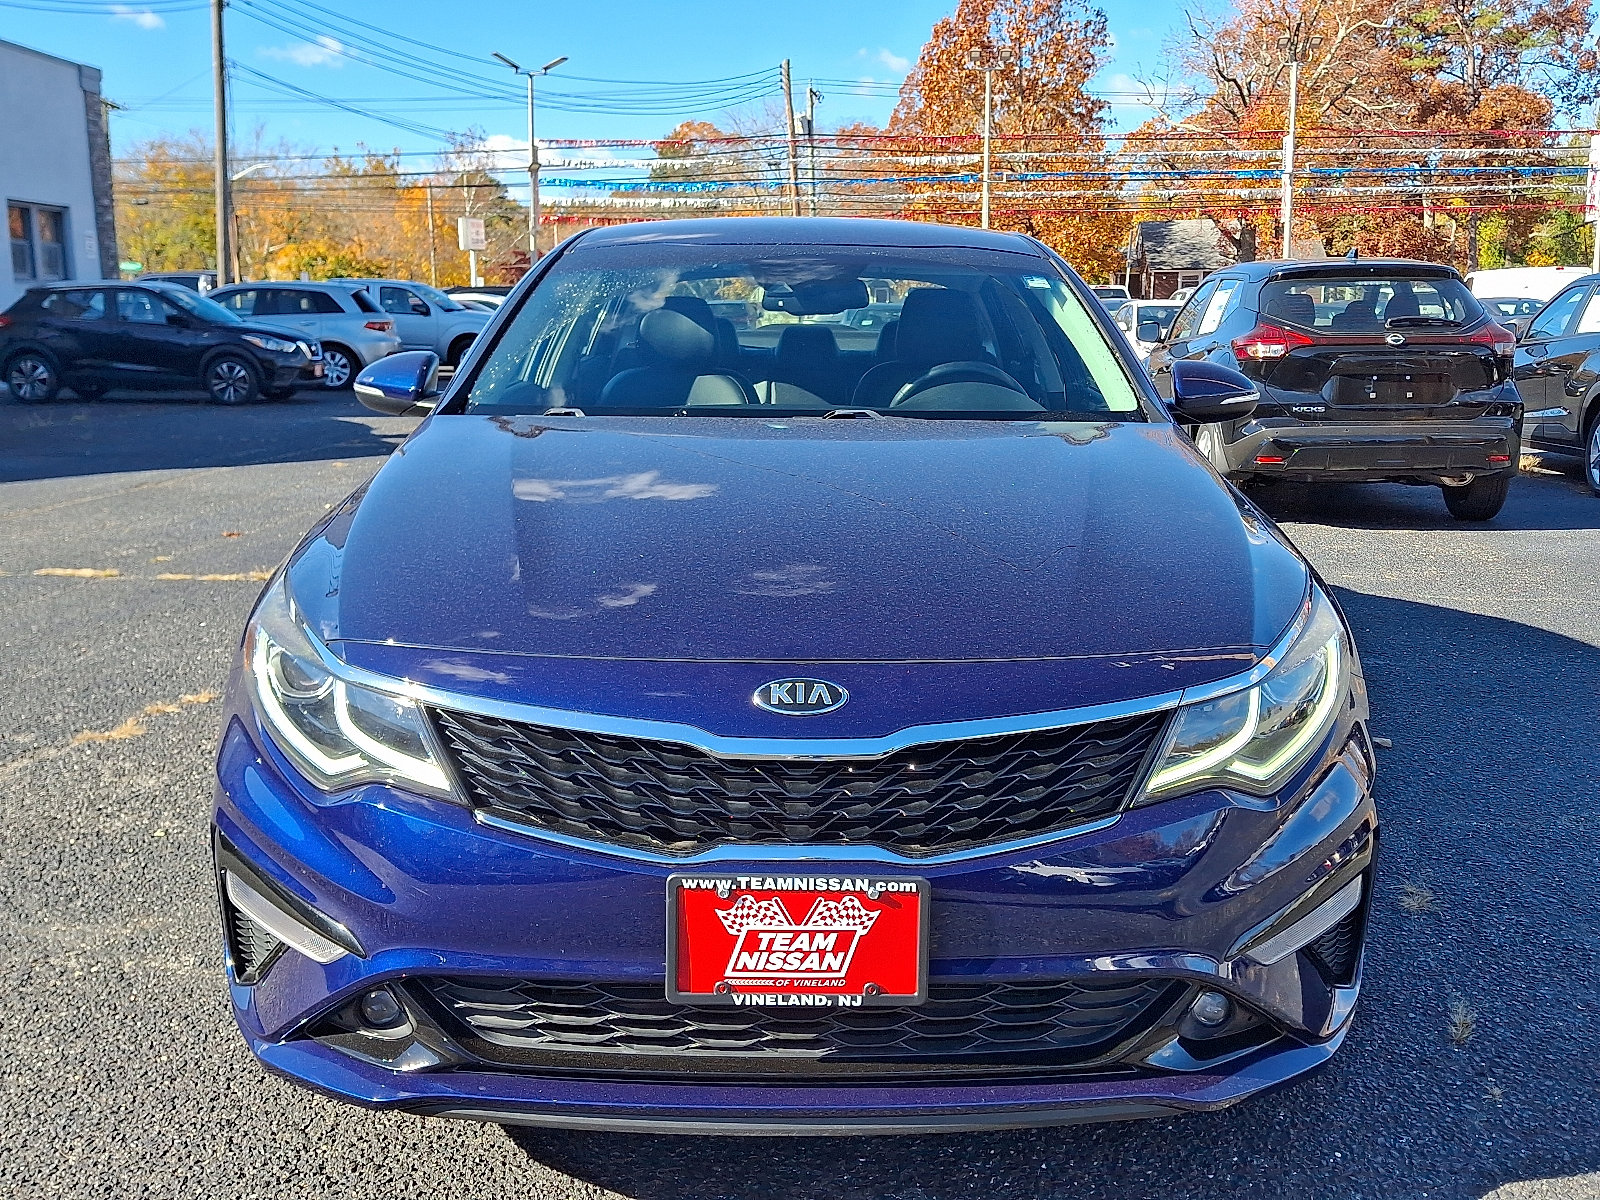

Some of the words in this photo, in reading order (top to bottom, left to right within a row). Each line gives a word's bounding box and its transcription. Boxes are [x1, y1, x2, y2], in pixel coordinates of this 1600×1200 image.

[770, 683, 832, 704] KIA
[681, 876, 917, 893] www.TEAMNISSAN.com
[758, 932, 839, 951] TEAM
[735, 951, 846, 971] NISSAN
[775, 979, 790, 987] OF
[793, 979, 846, 987] VINELAND
[731, 993, 832, 1006] VINELAND,
[838, 994, 863, 1007] NJ
